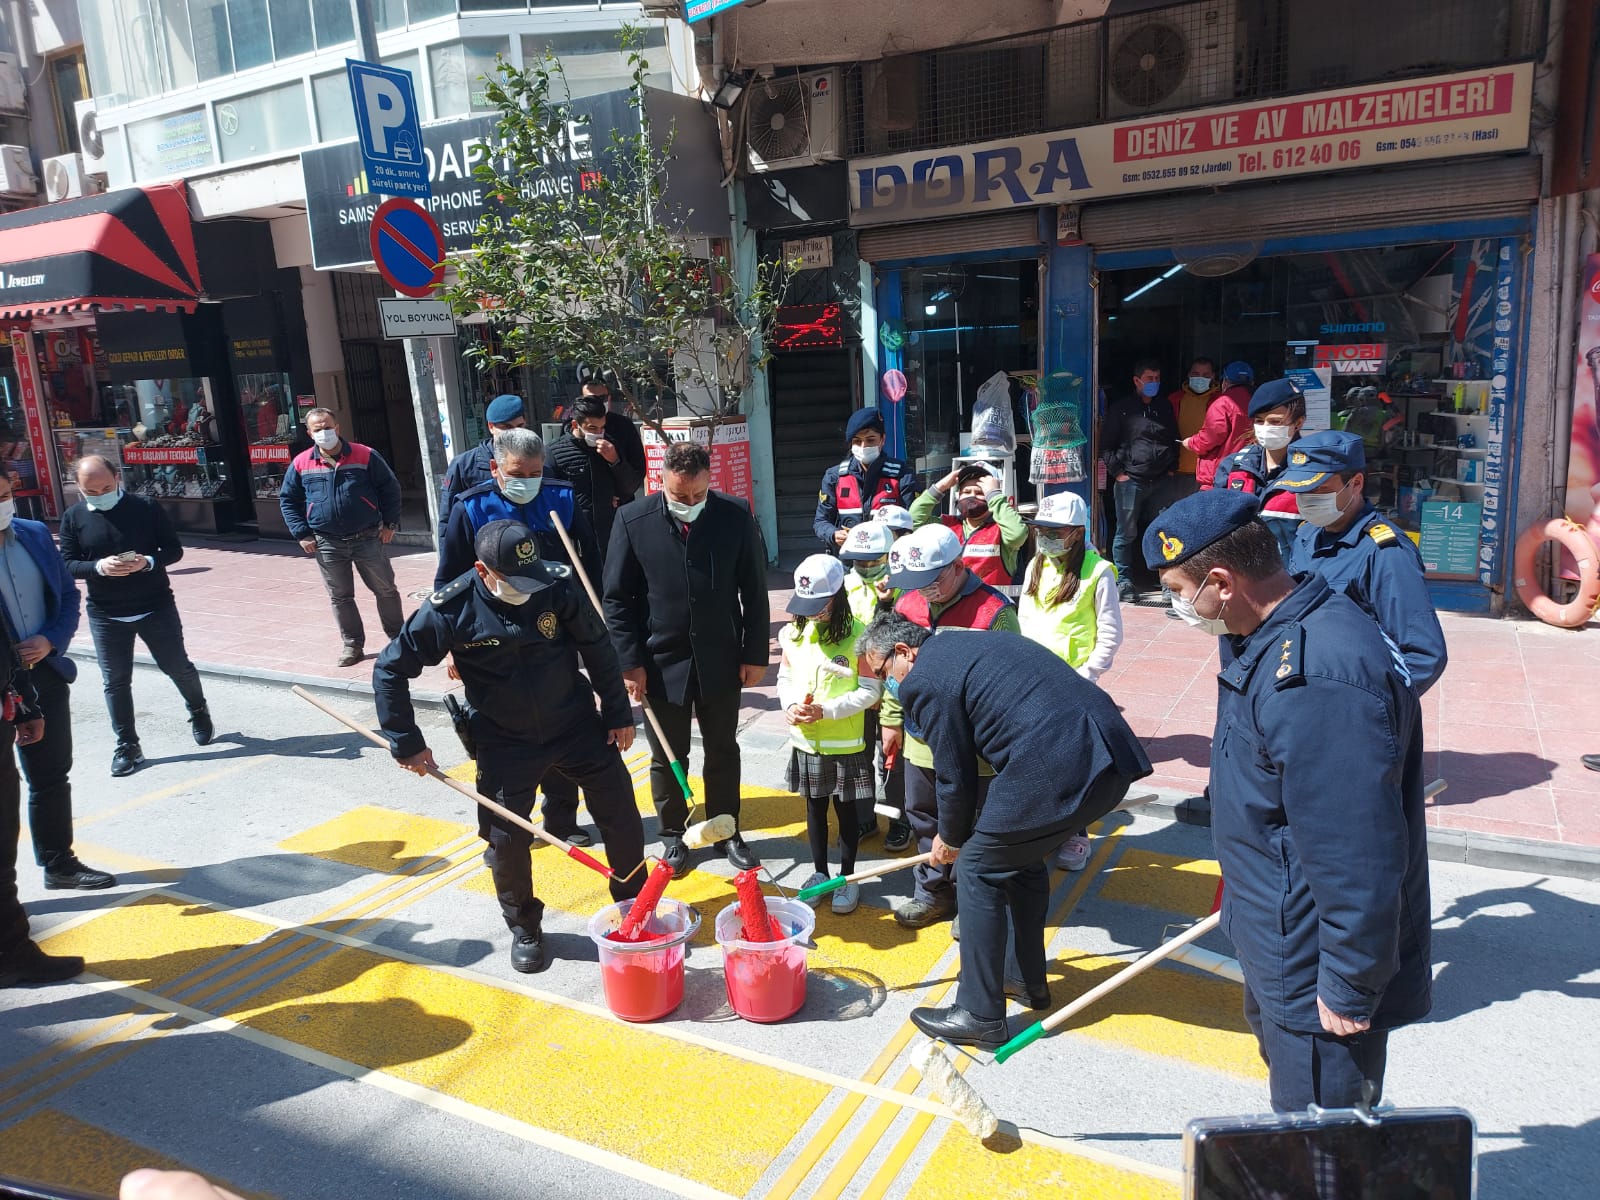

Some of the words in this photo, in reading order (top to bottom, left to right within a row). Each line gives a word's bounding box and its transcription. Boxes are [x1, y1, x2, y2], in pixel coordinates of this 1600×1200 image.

[361, 74, 406, 153] P
[1127, 118, 1195, 157] DENİZ
[1211, 116, 1239, 147] VE
[1255, 110, 1288, 141] AV
[1303, 74, 1496, 134] MALZEMELERİ
[1376, 140, 1398, 152] Gsm:
[1238, 152, 1267, 173] Tel.
[1273, 146, 1305, 169] 612
[1309, 142, 1333, 165] 40
[1338, 139, 1361, 162] 06
[856, 138, 1093, 209] DORA
[1122, 173, 1140, 183] Gsm:
[7, 274, 45, 288] JEWELLERY
[385, 313, 406, 323] YOL
[408, 312, 451, 323] BOYUNCA
[1320, 322, 1386, 333] SHIMANO
[1315, 344, 1382, 359] RYOBI
[1334, 360, 1382, 373] VMC
[251, 449, 267, 459] ALTIN
[268, 448, 289, 459] ALINIR
[1441, 505, 1463, 519] 14
